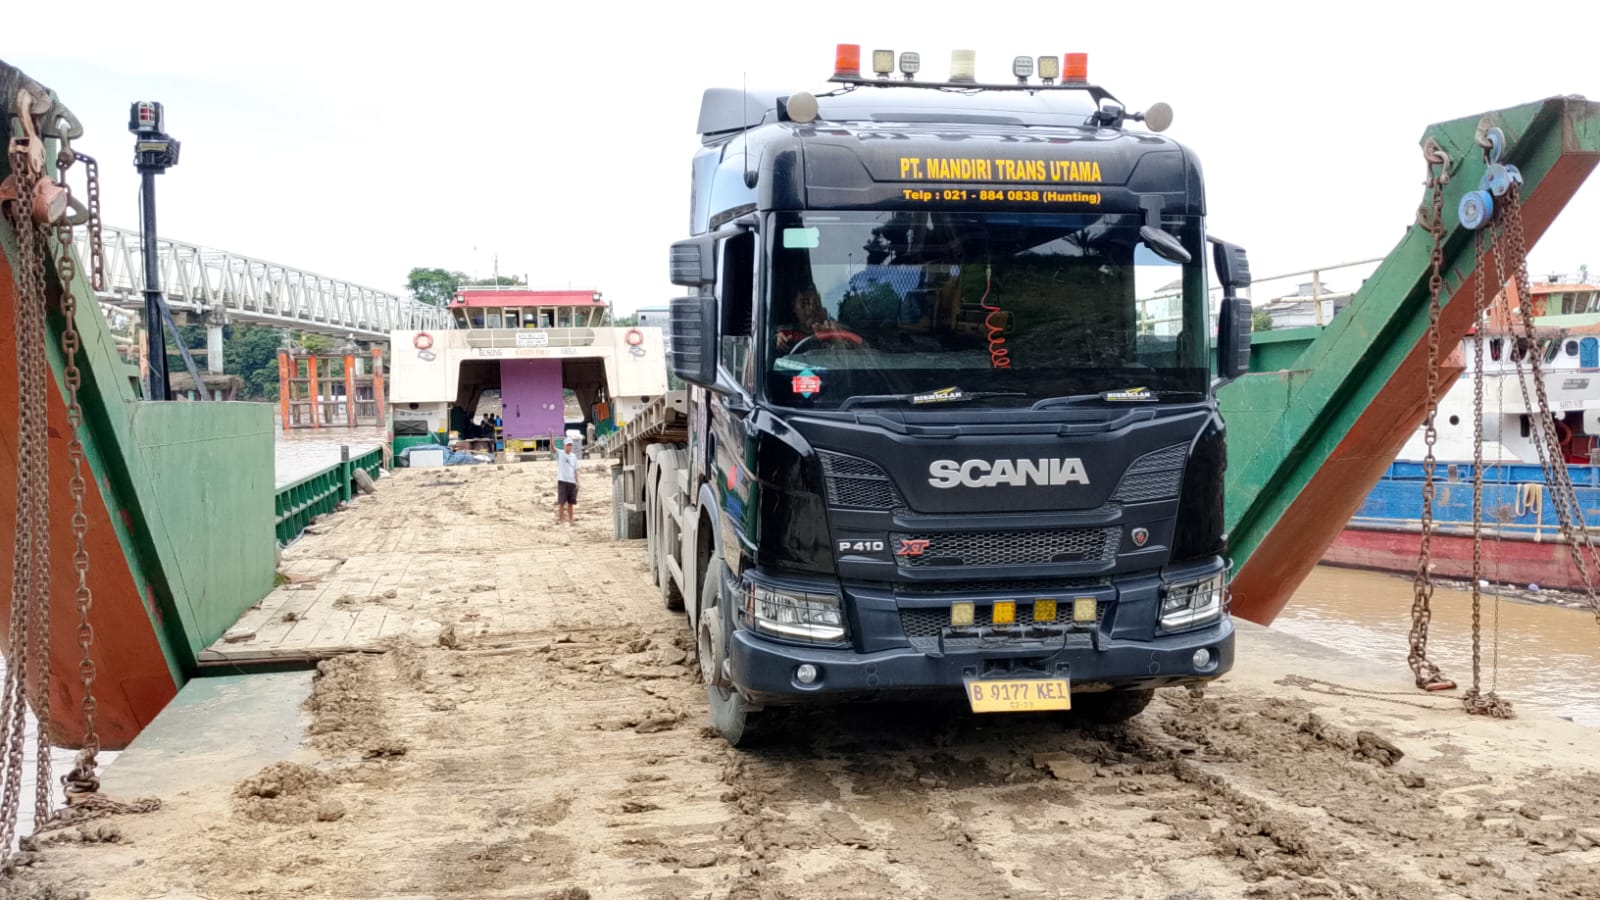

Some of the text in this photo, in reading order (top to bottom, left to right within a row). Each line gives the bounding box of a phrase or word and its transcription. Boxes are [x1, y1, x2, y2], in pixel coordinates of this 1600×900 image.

[900, 157, 1102, 182] PT. MANDIRI TRANS UTAMA
[903, 189, 932, 202] Telp
[943, 189, 967, 200] 021
[979, 190, 1004, 201] 884
[1007, 190, 1040, 201] 0838
[1042, 191, 1102, 205] (Hunting)
[928, 457, 1090, 489] SCANIA
[839, 541, 884, 552] P 410
[896, 539, 930, 556] XT
[972, 684, 984, 701] B
[990, 683, 1029, 701] 9177
